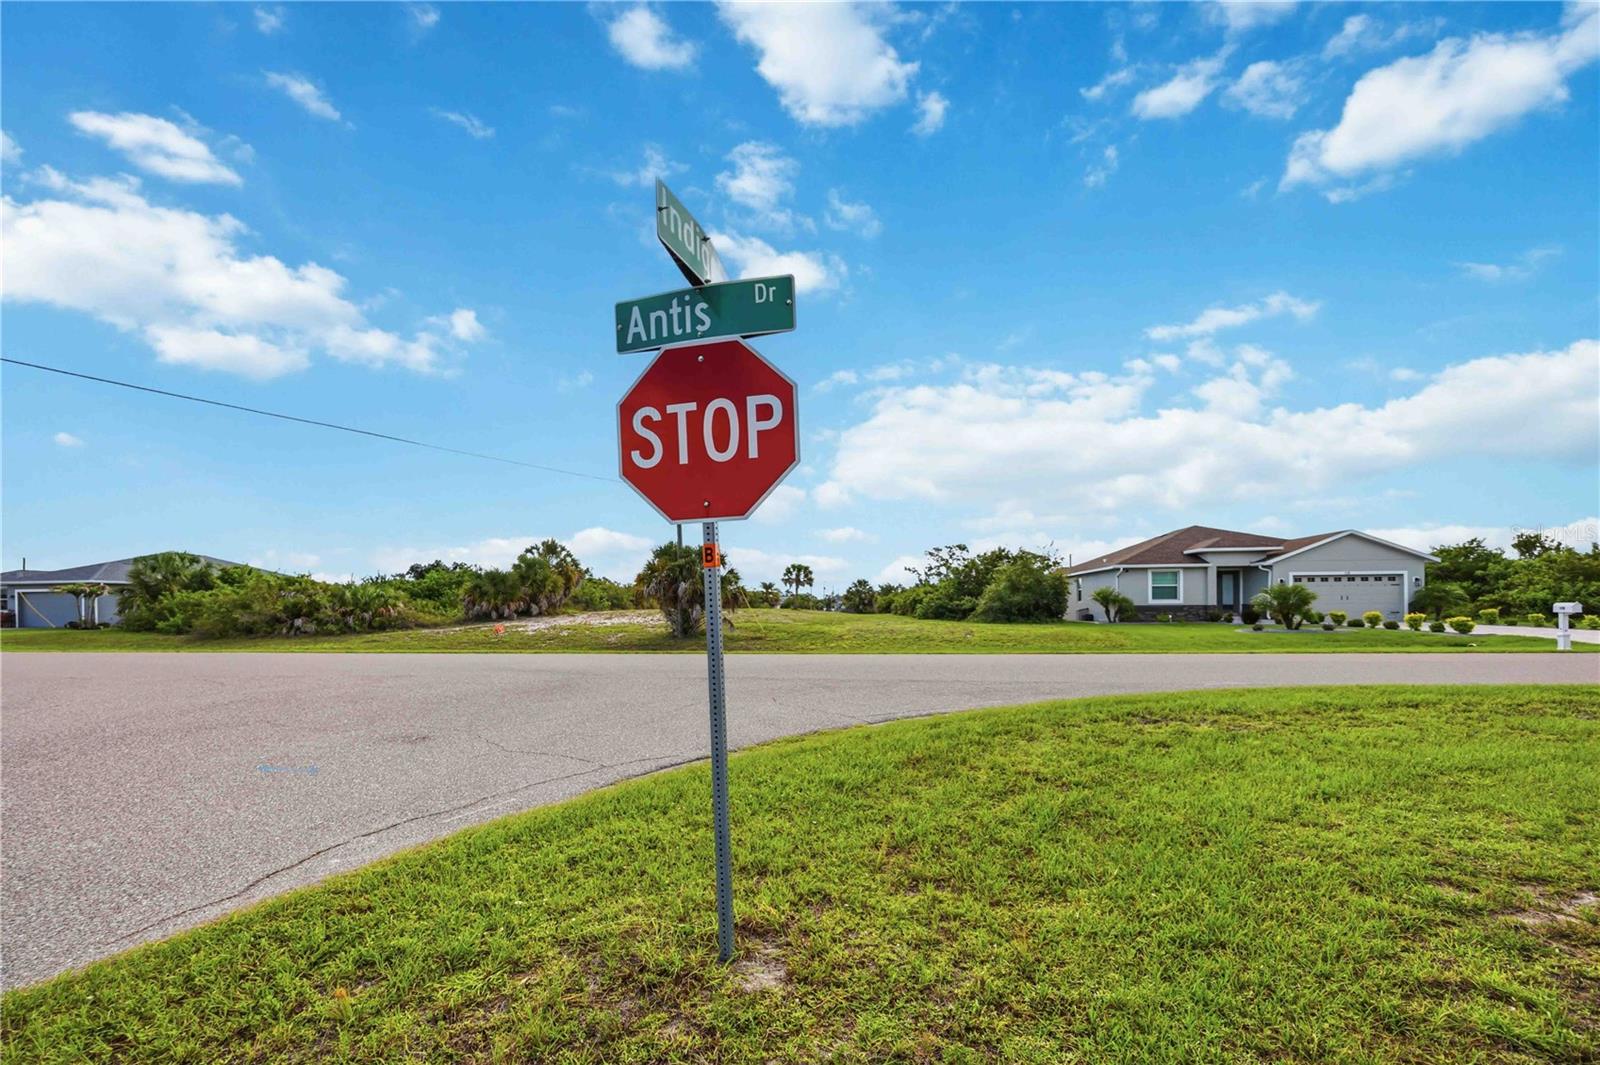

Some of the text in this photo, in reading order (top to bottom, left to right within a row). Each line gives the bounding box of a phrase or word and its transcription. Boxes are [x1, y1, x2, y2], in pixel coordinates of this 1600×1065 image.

[662, 186, 711, 280] Indig
[626, 283, 776, 344] Antis Dr
[631, 394, 783, 469] STOP
[704, 547, 714, 563] B
